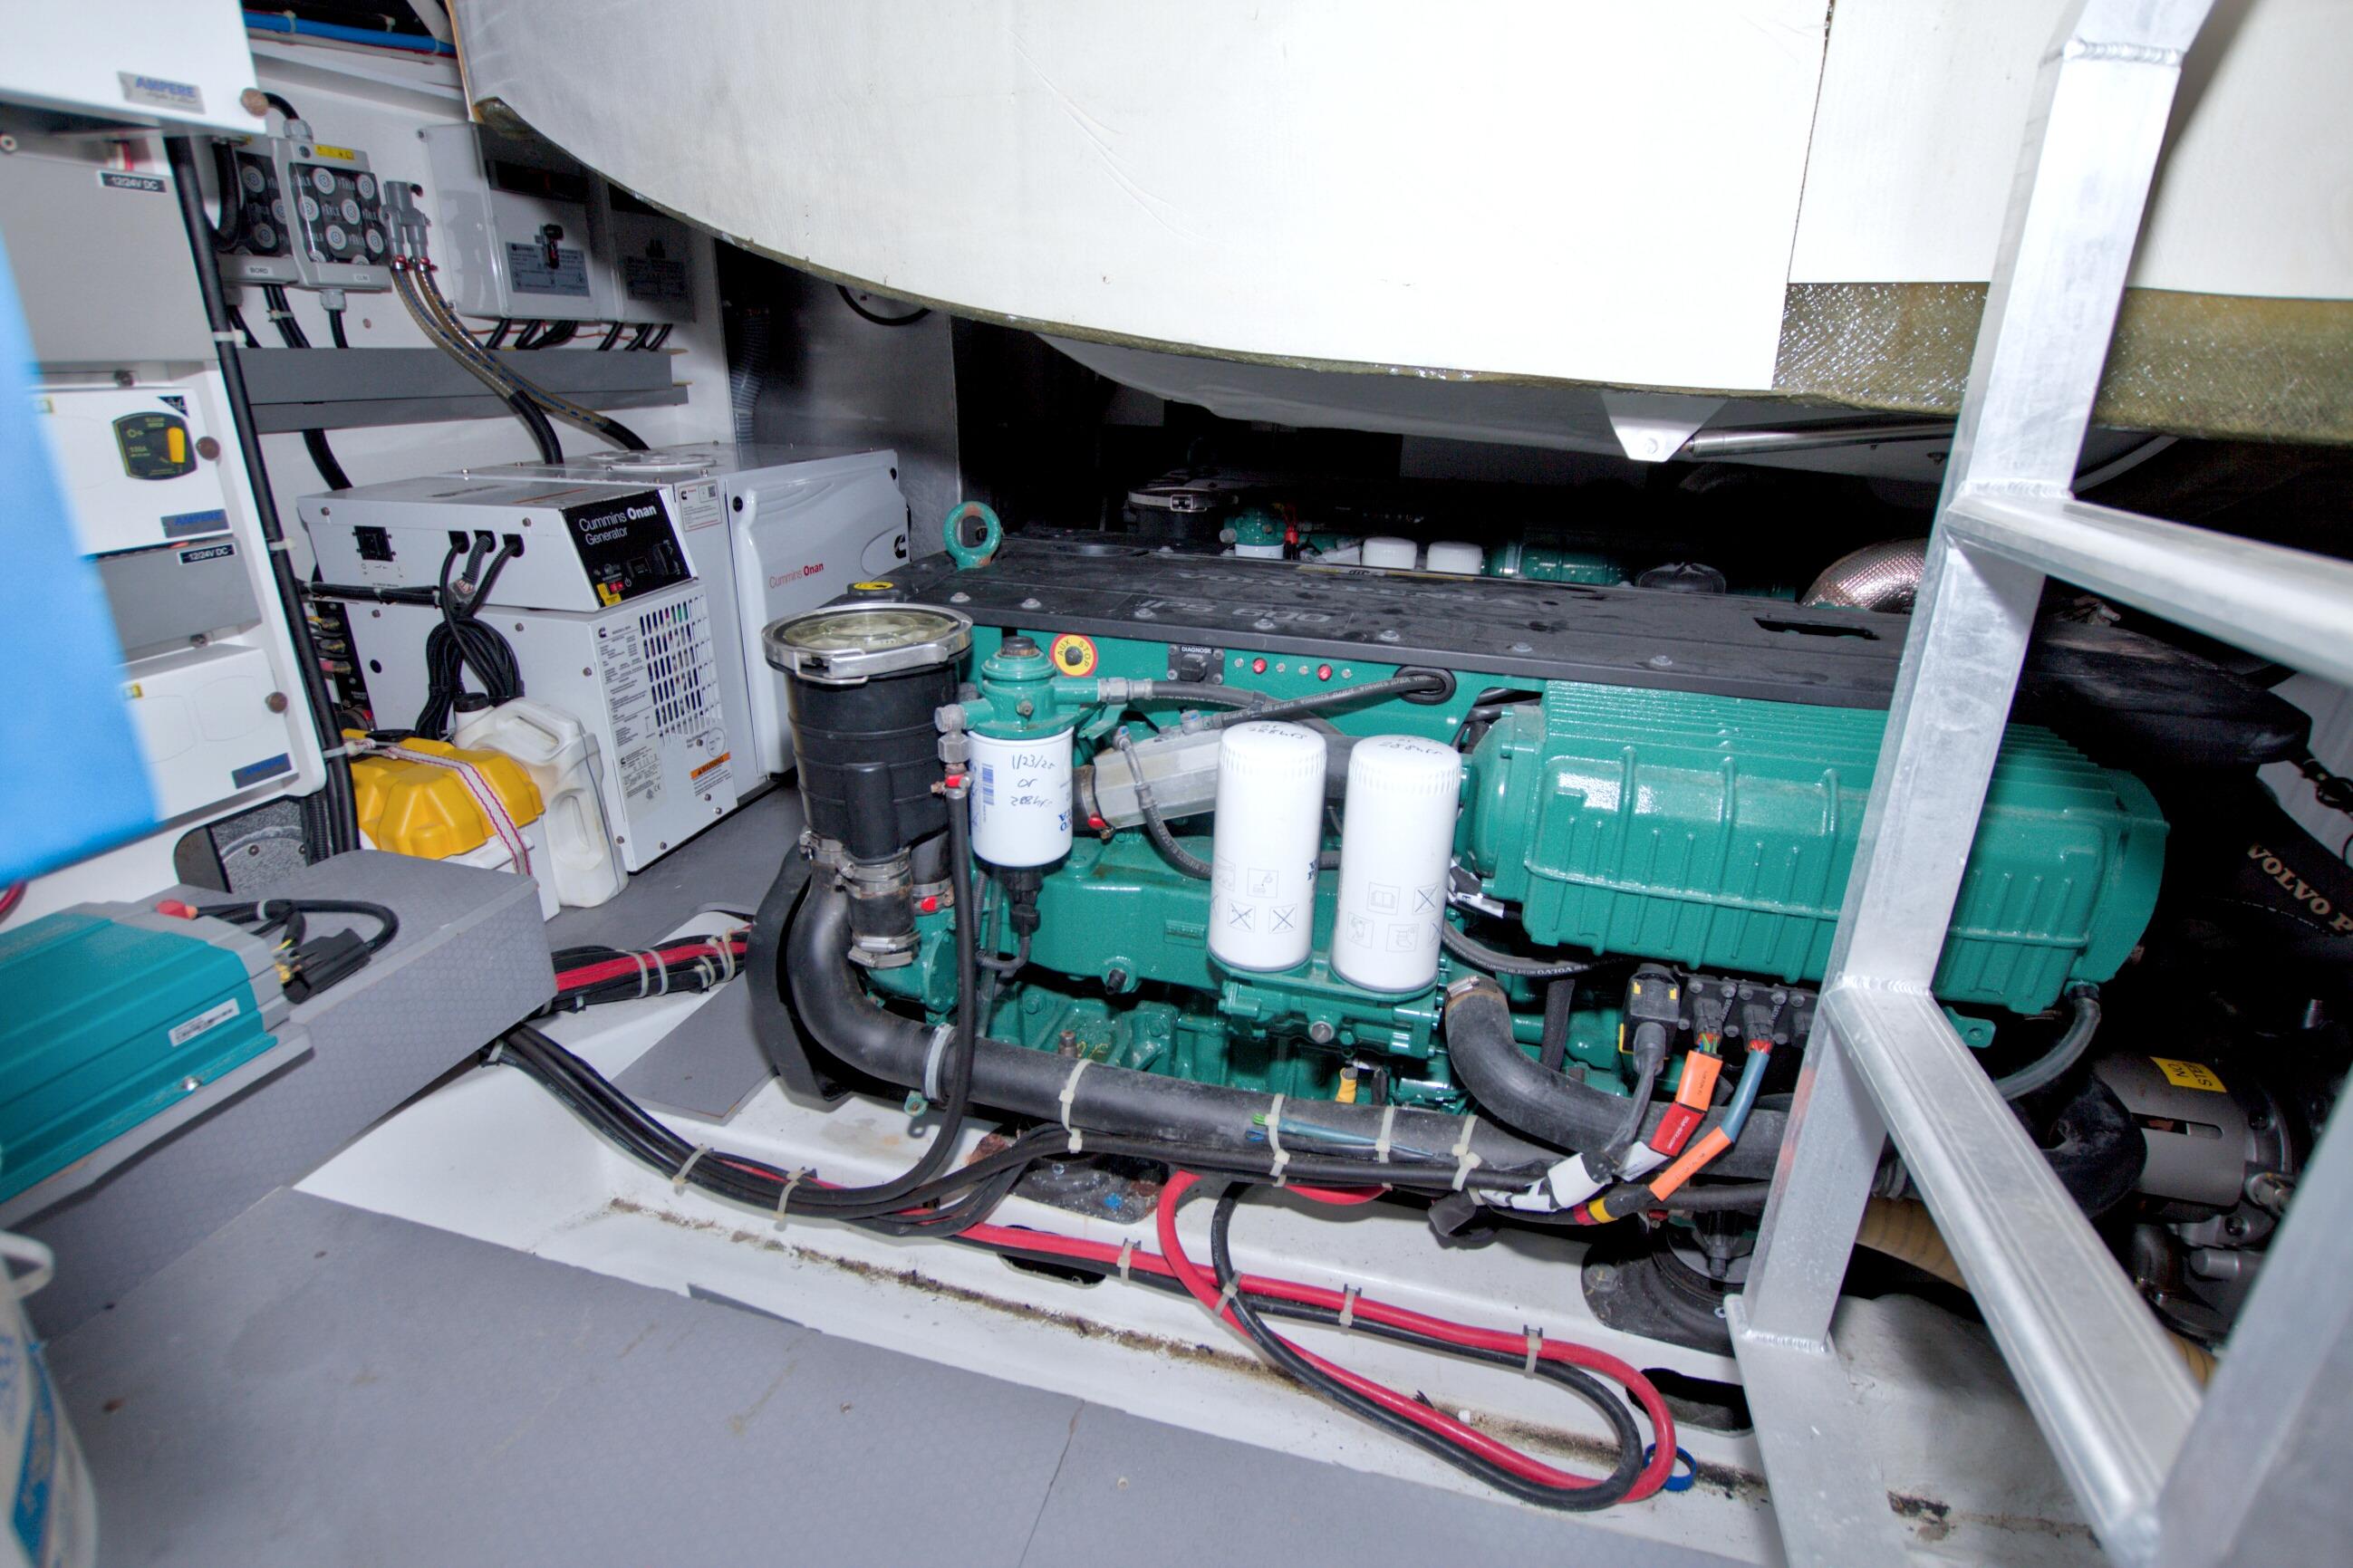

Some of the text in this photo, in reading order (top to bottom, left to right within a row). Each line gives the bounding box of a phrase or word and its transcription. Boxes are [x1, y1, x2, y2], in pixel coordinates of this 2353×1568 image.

[143, 179, 159, 189] DC
[578, 505, 657, 532] Cummins Onan
[585, 526, 628, 545] Generator
[216, 546, 228, 556] DC
[769, 563, 824, 589] Cummins Onan
[1138, 599, 1332, 623] IPS 600
[1057, 639, 1091, 668] AUX STOP
[1181, 646, 1212, 654] DIAGNOSE
[1017, 778, 1038, 788] or
[2247, 842, 2332, 916] VOLVO
[1537, 967, 1574, 976] VOLVO
[2166, 1063, 2189, 1079] NO
[2183, 1063, 2213, 1087] STEP
